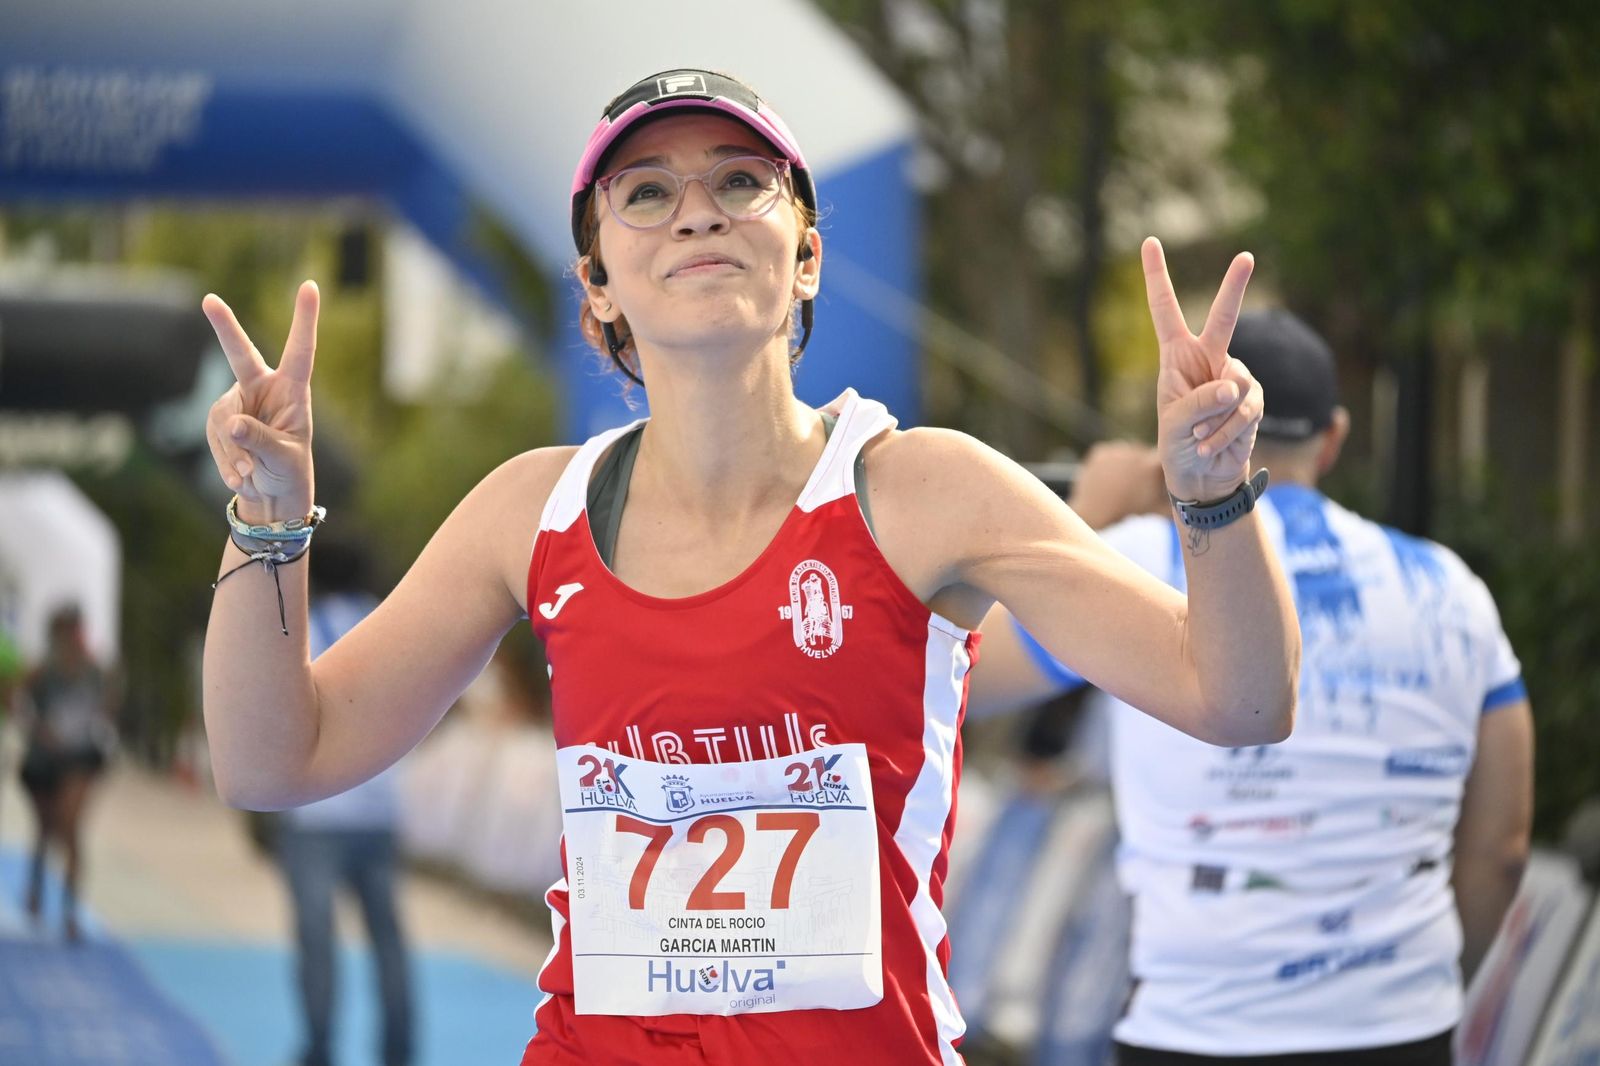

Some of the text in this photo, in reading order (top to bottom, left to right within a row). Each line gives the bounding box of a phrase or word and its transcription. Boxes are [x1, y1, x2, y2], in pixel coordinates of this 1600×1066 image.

[778, 605, 792, 620] 19
[800, 639, 841, 659] HUELVA
[823, 781, 842, 790] RUN
[580, 791, 639, 813] HUELVA
[700, 795, 755, 805] HUELVA
[790, 790, 852, 805] HUELVA
[615, 812, 821, 911] 727
[575, 856, 586, 899] 03.11.2024
[668, 917, 766, 929] CINTA DEL ROCIO
[660, 938, 776, 953] GARCIA MARTIN
[698, 968, 711, 985] RUN
[729, 994, 776, 1009] original
